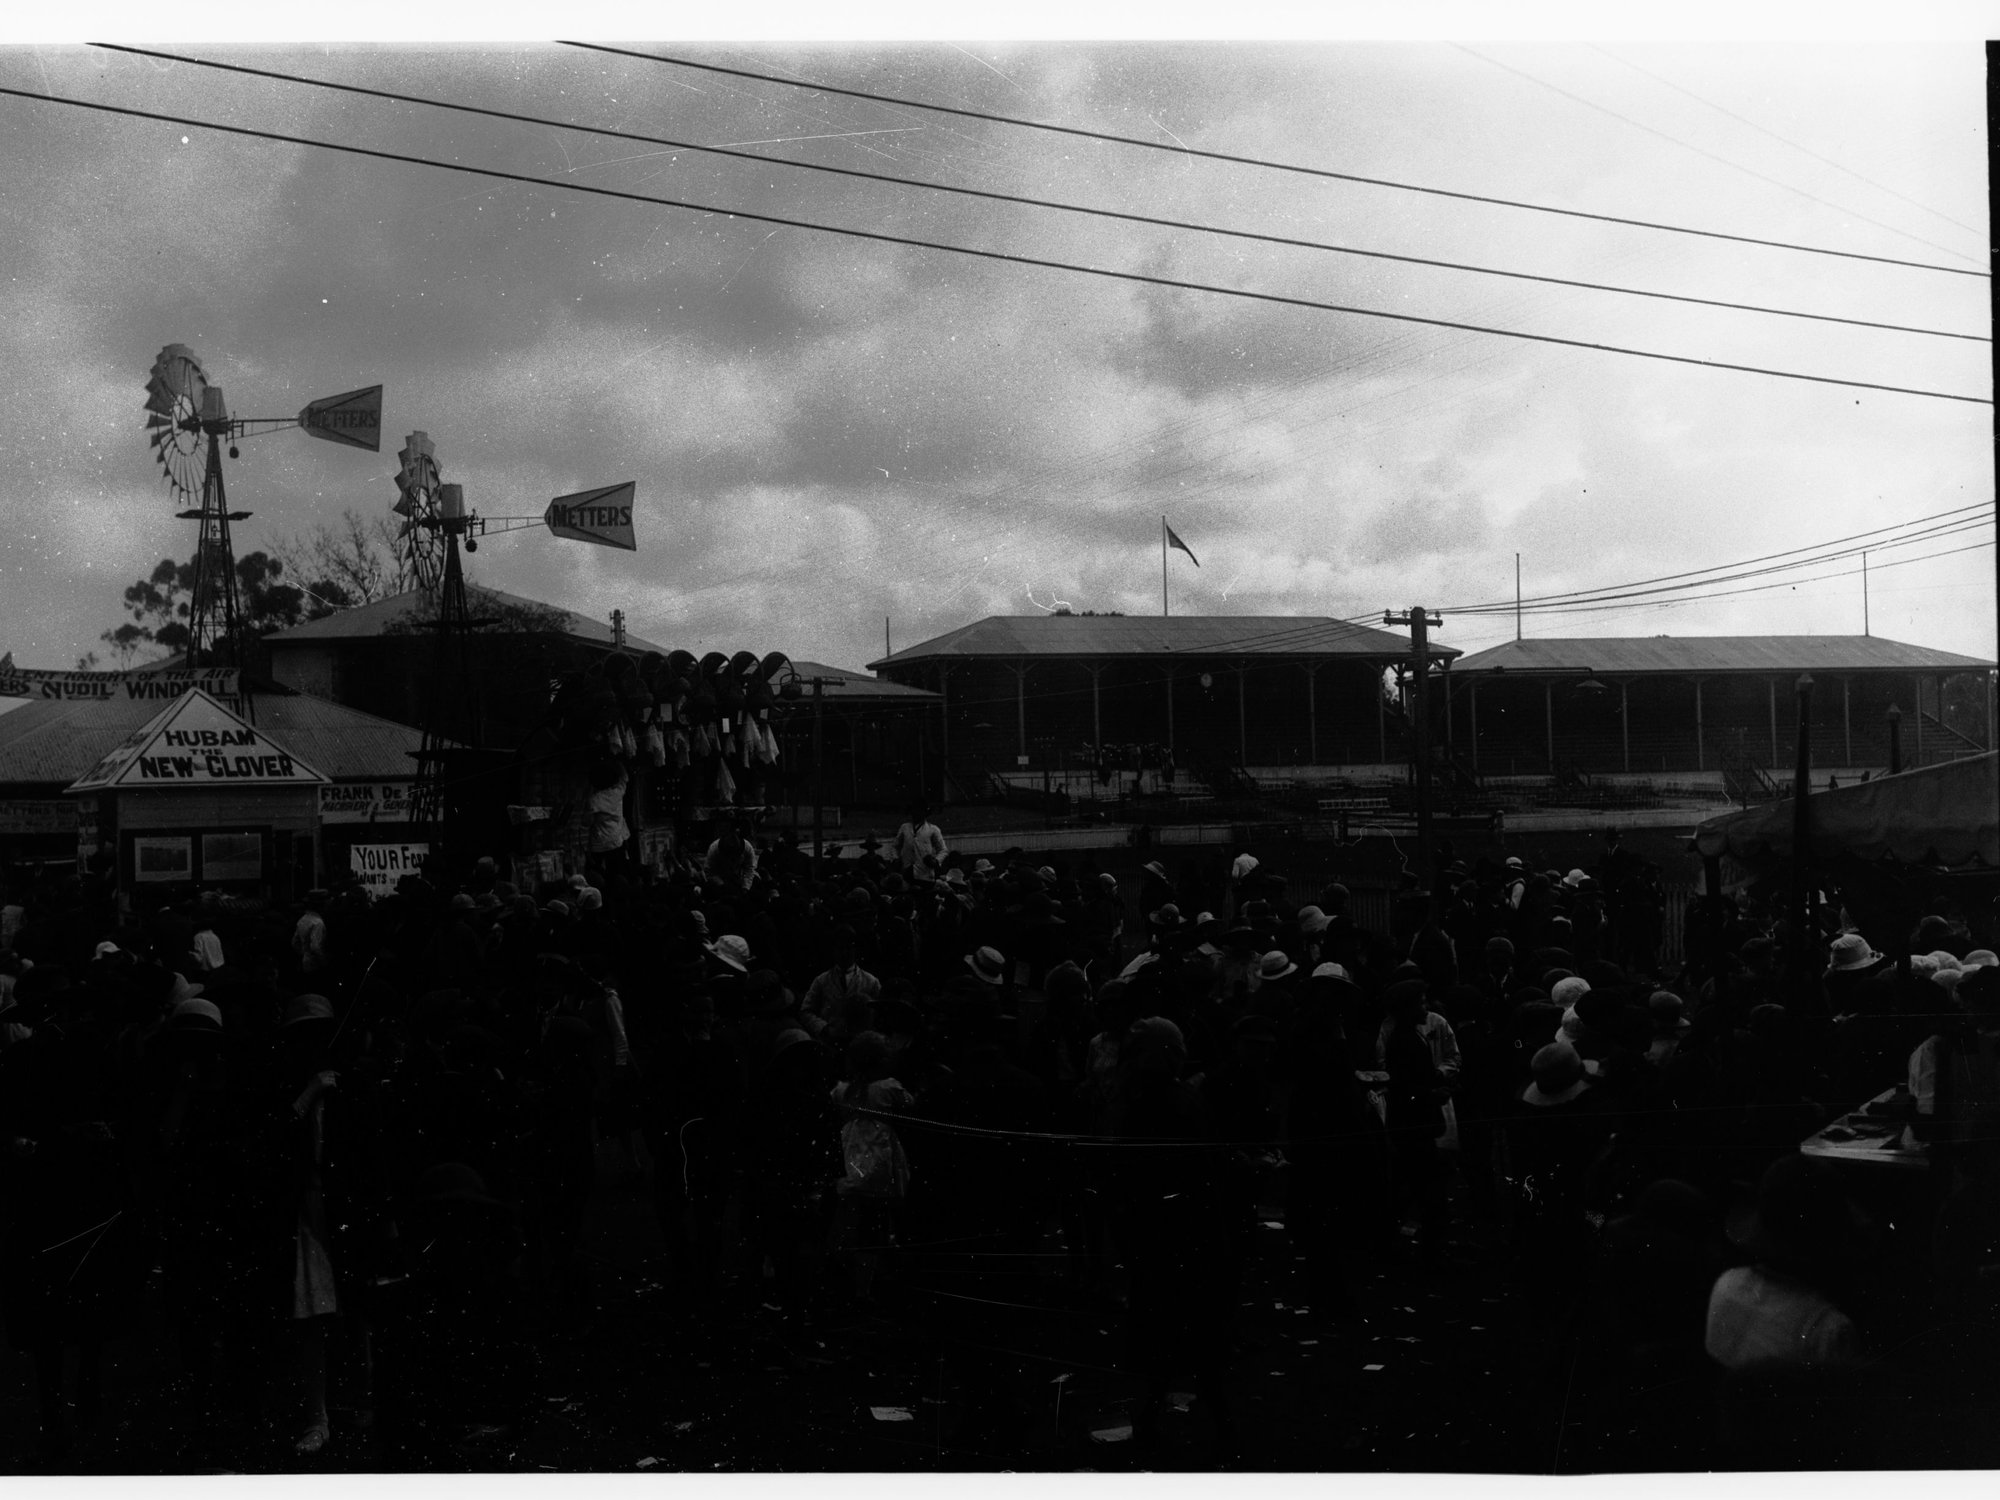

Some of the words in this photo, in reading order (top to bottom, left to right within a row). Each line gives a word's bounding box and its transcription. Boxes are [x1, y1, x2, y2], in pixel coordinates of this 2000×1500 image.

[308, 407, 378, 429] METTERS
[553, 505, 632, 528] METTERS
[64, 671, 131, 682] KNIGHT
[138, 671, 159, 681] OF
[166, 670, 197, 680] THE
[202, 669, 235, 679] AIR
[166, 731, 256, 746] HUBAM
[189, 748, 223, 756] THE
[140, 757, 194, 778] NEW
[206, 756, 295, 778] CLOVER
[321, 786, 374, 801] FRANK
[356, 847, 401, 870] YOUR
[354, 871, 387, 885] WANTS
